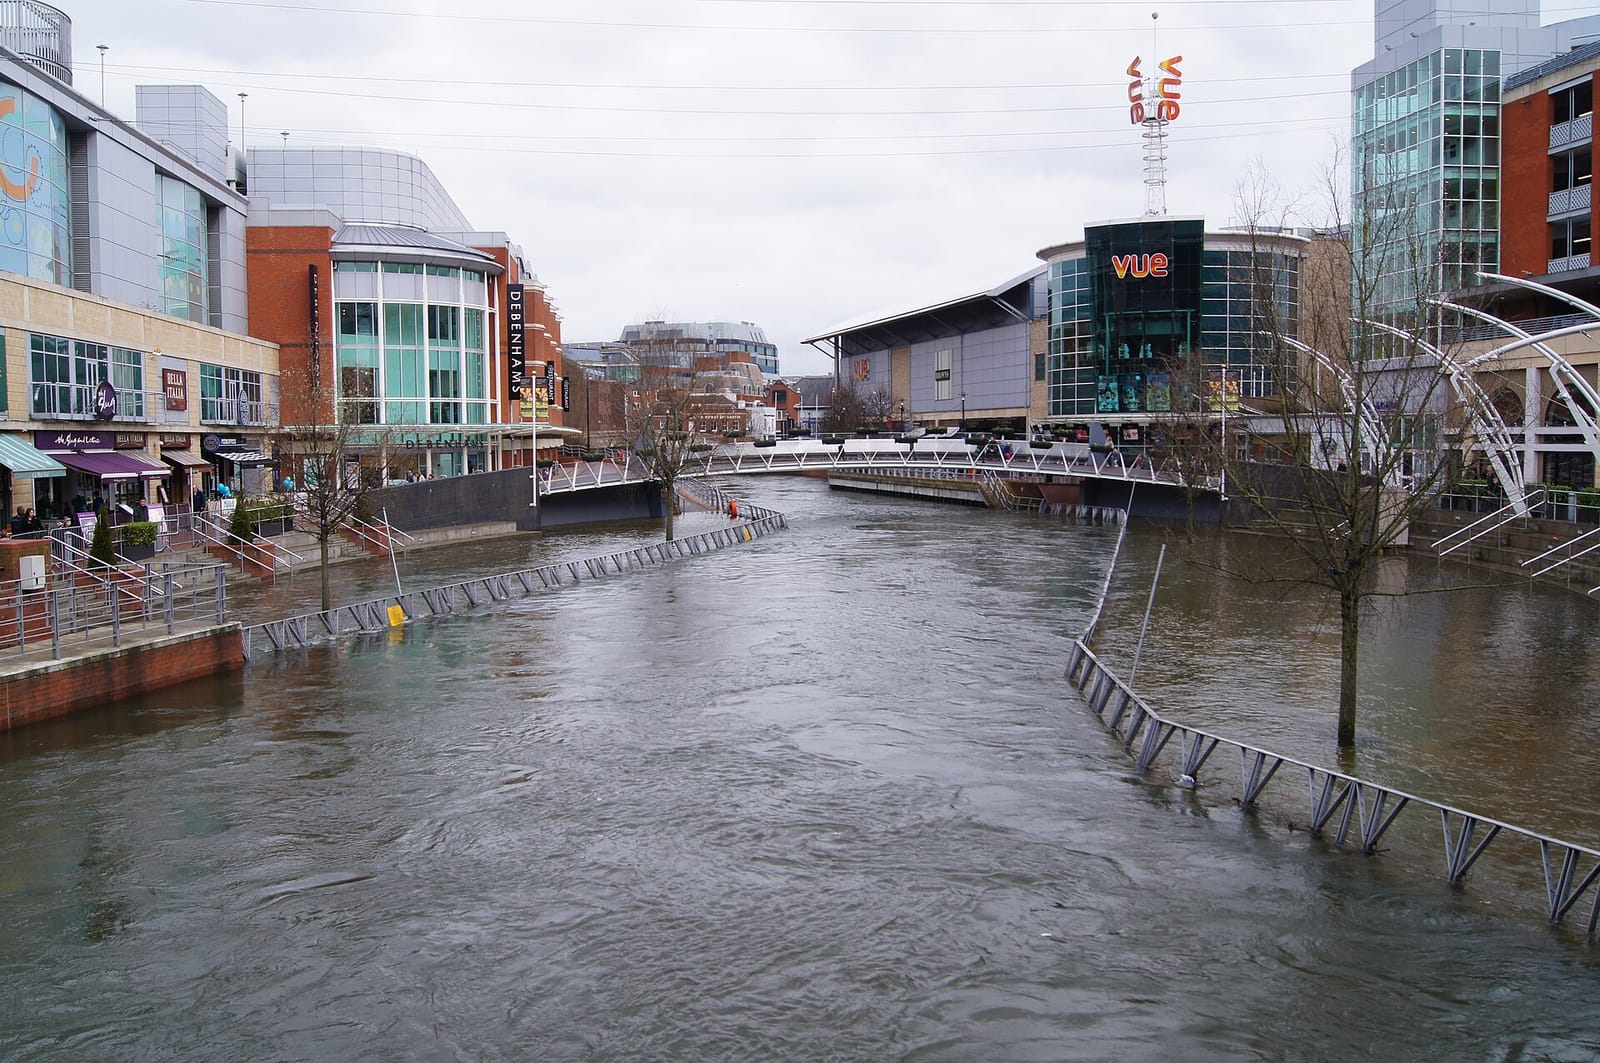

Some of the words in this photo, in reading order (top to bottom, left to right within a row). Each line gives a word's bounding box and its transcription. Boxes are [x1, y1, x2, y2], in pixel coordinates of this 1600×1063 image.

[1158, 56, 1182, 120] vue
[1111, 252, 1169, 279] vue
[510, 291, 522, 393] DEBENHAMS
[167, 372, 184, 386] BELLA
[166, 386, 184, 400] ITALIA
